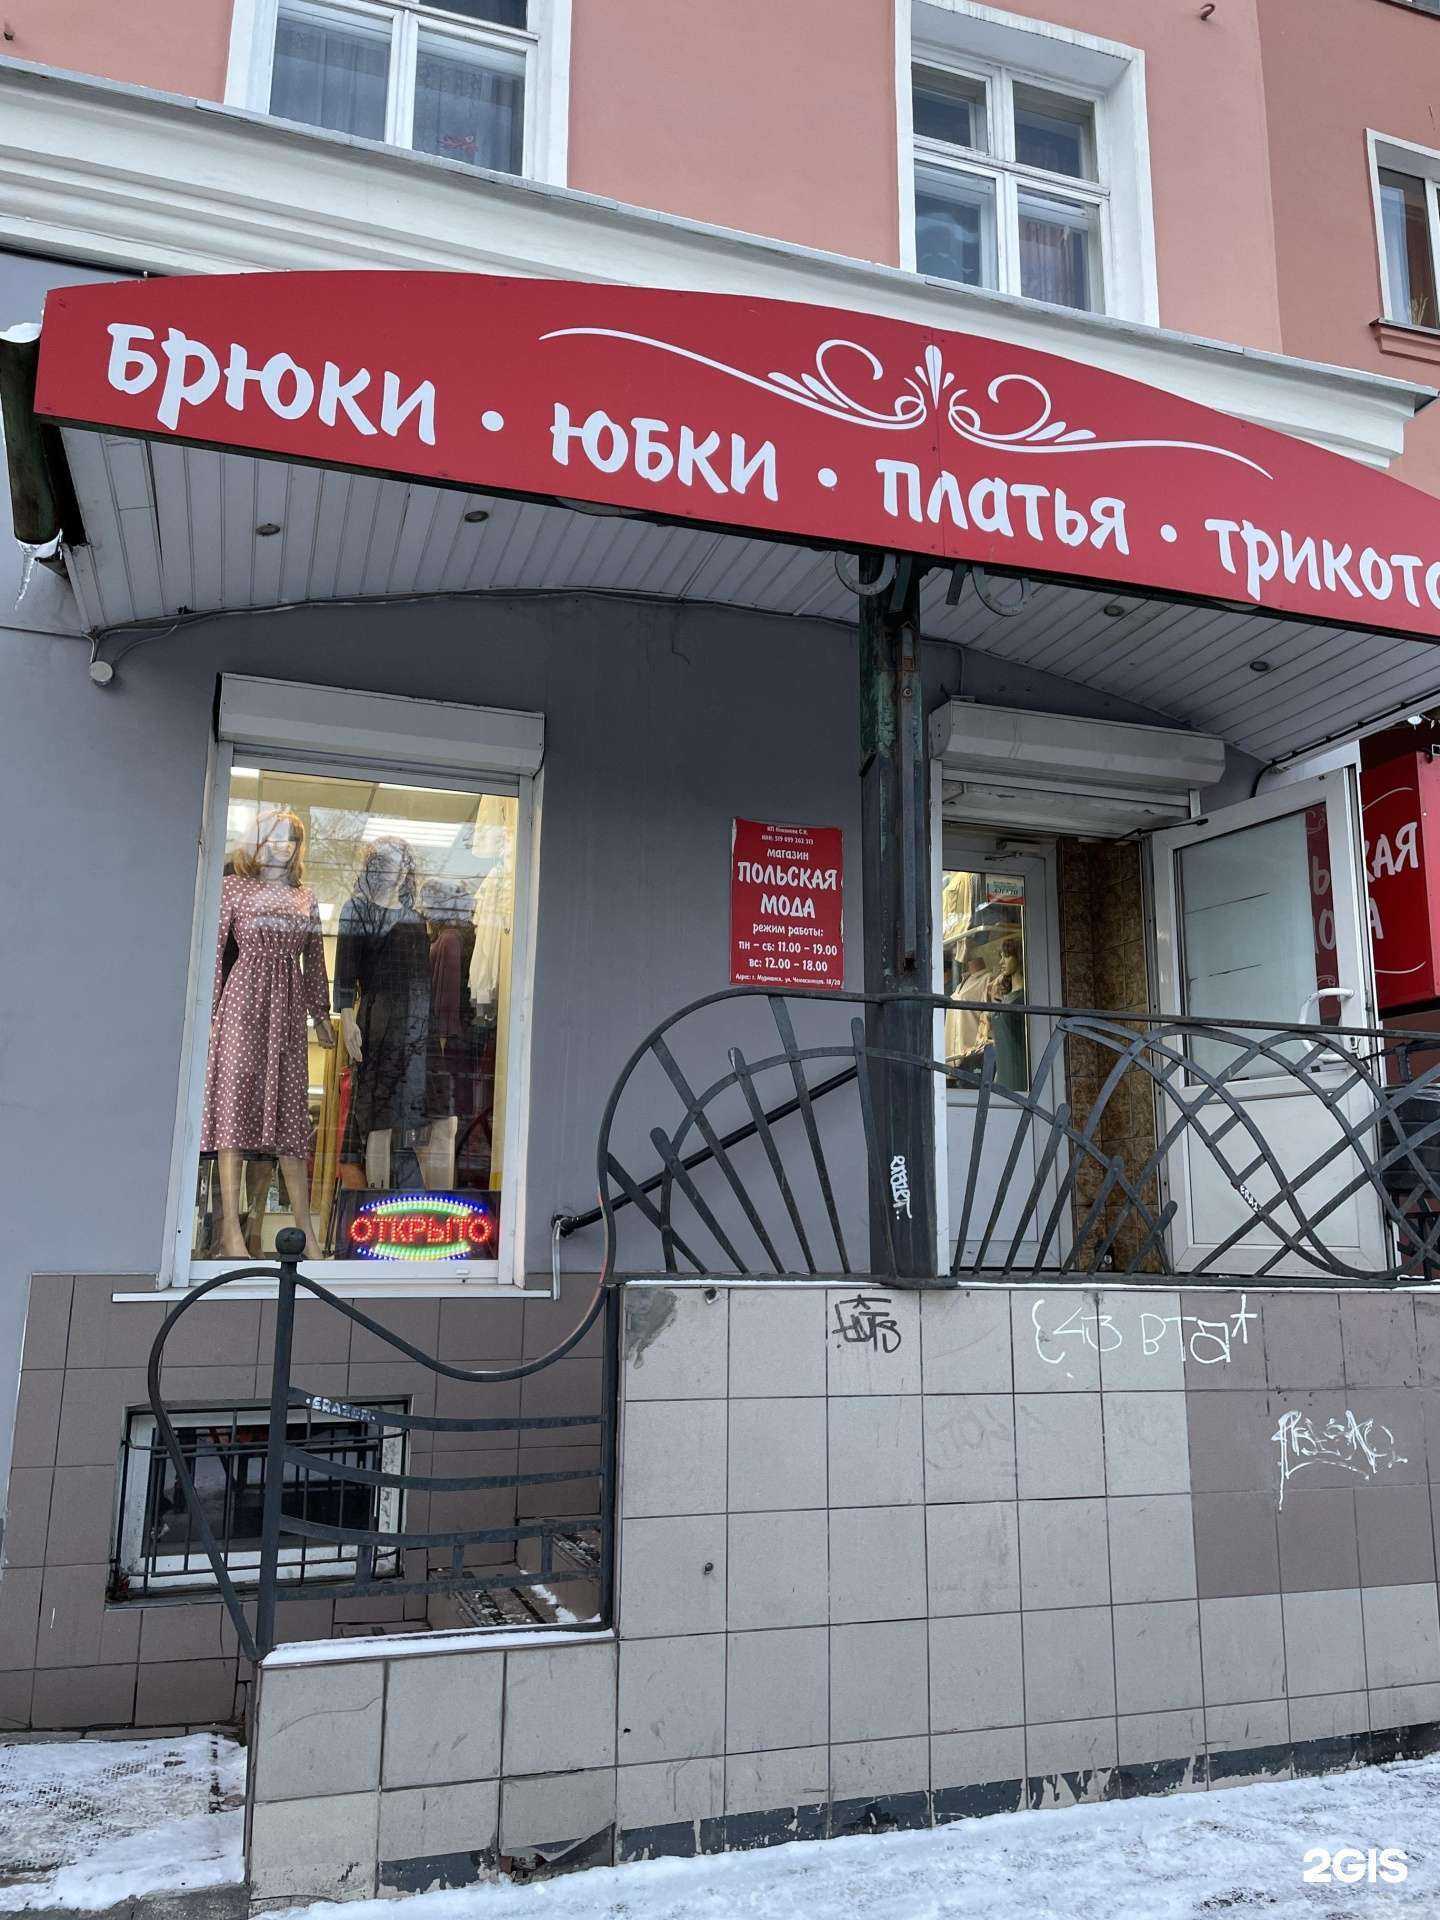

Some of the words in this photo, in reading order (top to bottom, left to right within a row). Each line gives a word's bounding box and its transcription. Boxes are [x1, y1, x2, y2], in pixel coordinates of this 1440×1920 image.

[737, 861, 838, 891] ПОЛЬСКАЯ
[760, 893, 816, 919] МОДА
[752, 923, 786, 935] режим
[777, 941, 801, 954] 11.00
[812, 943, 838, 956] 19.00
[764, 956, 791, 970] 12.00
[802, 959, 828, 972] 18.00
[350, 1214, 491, 1244] ОТКРЫТО
